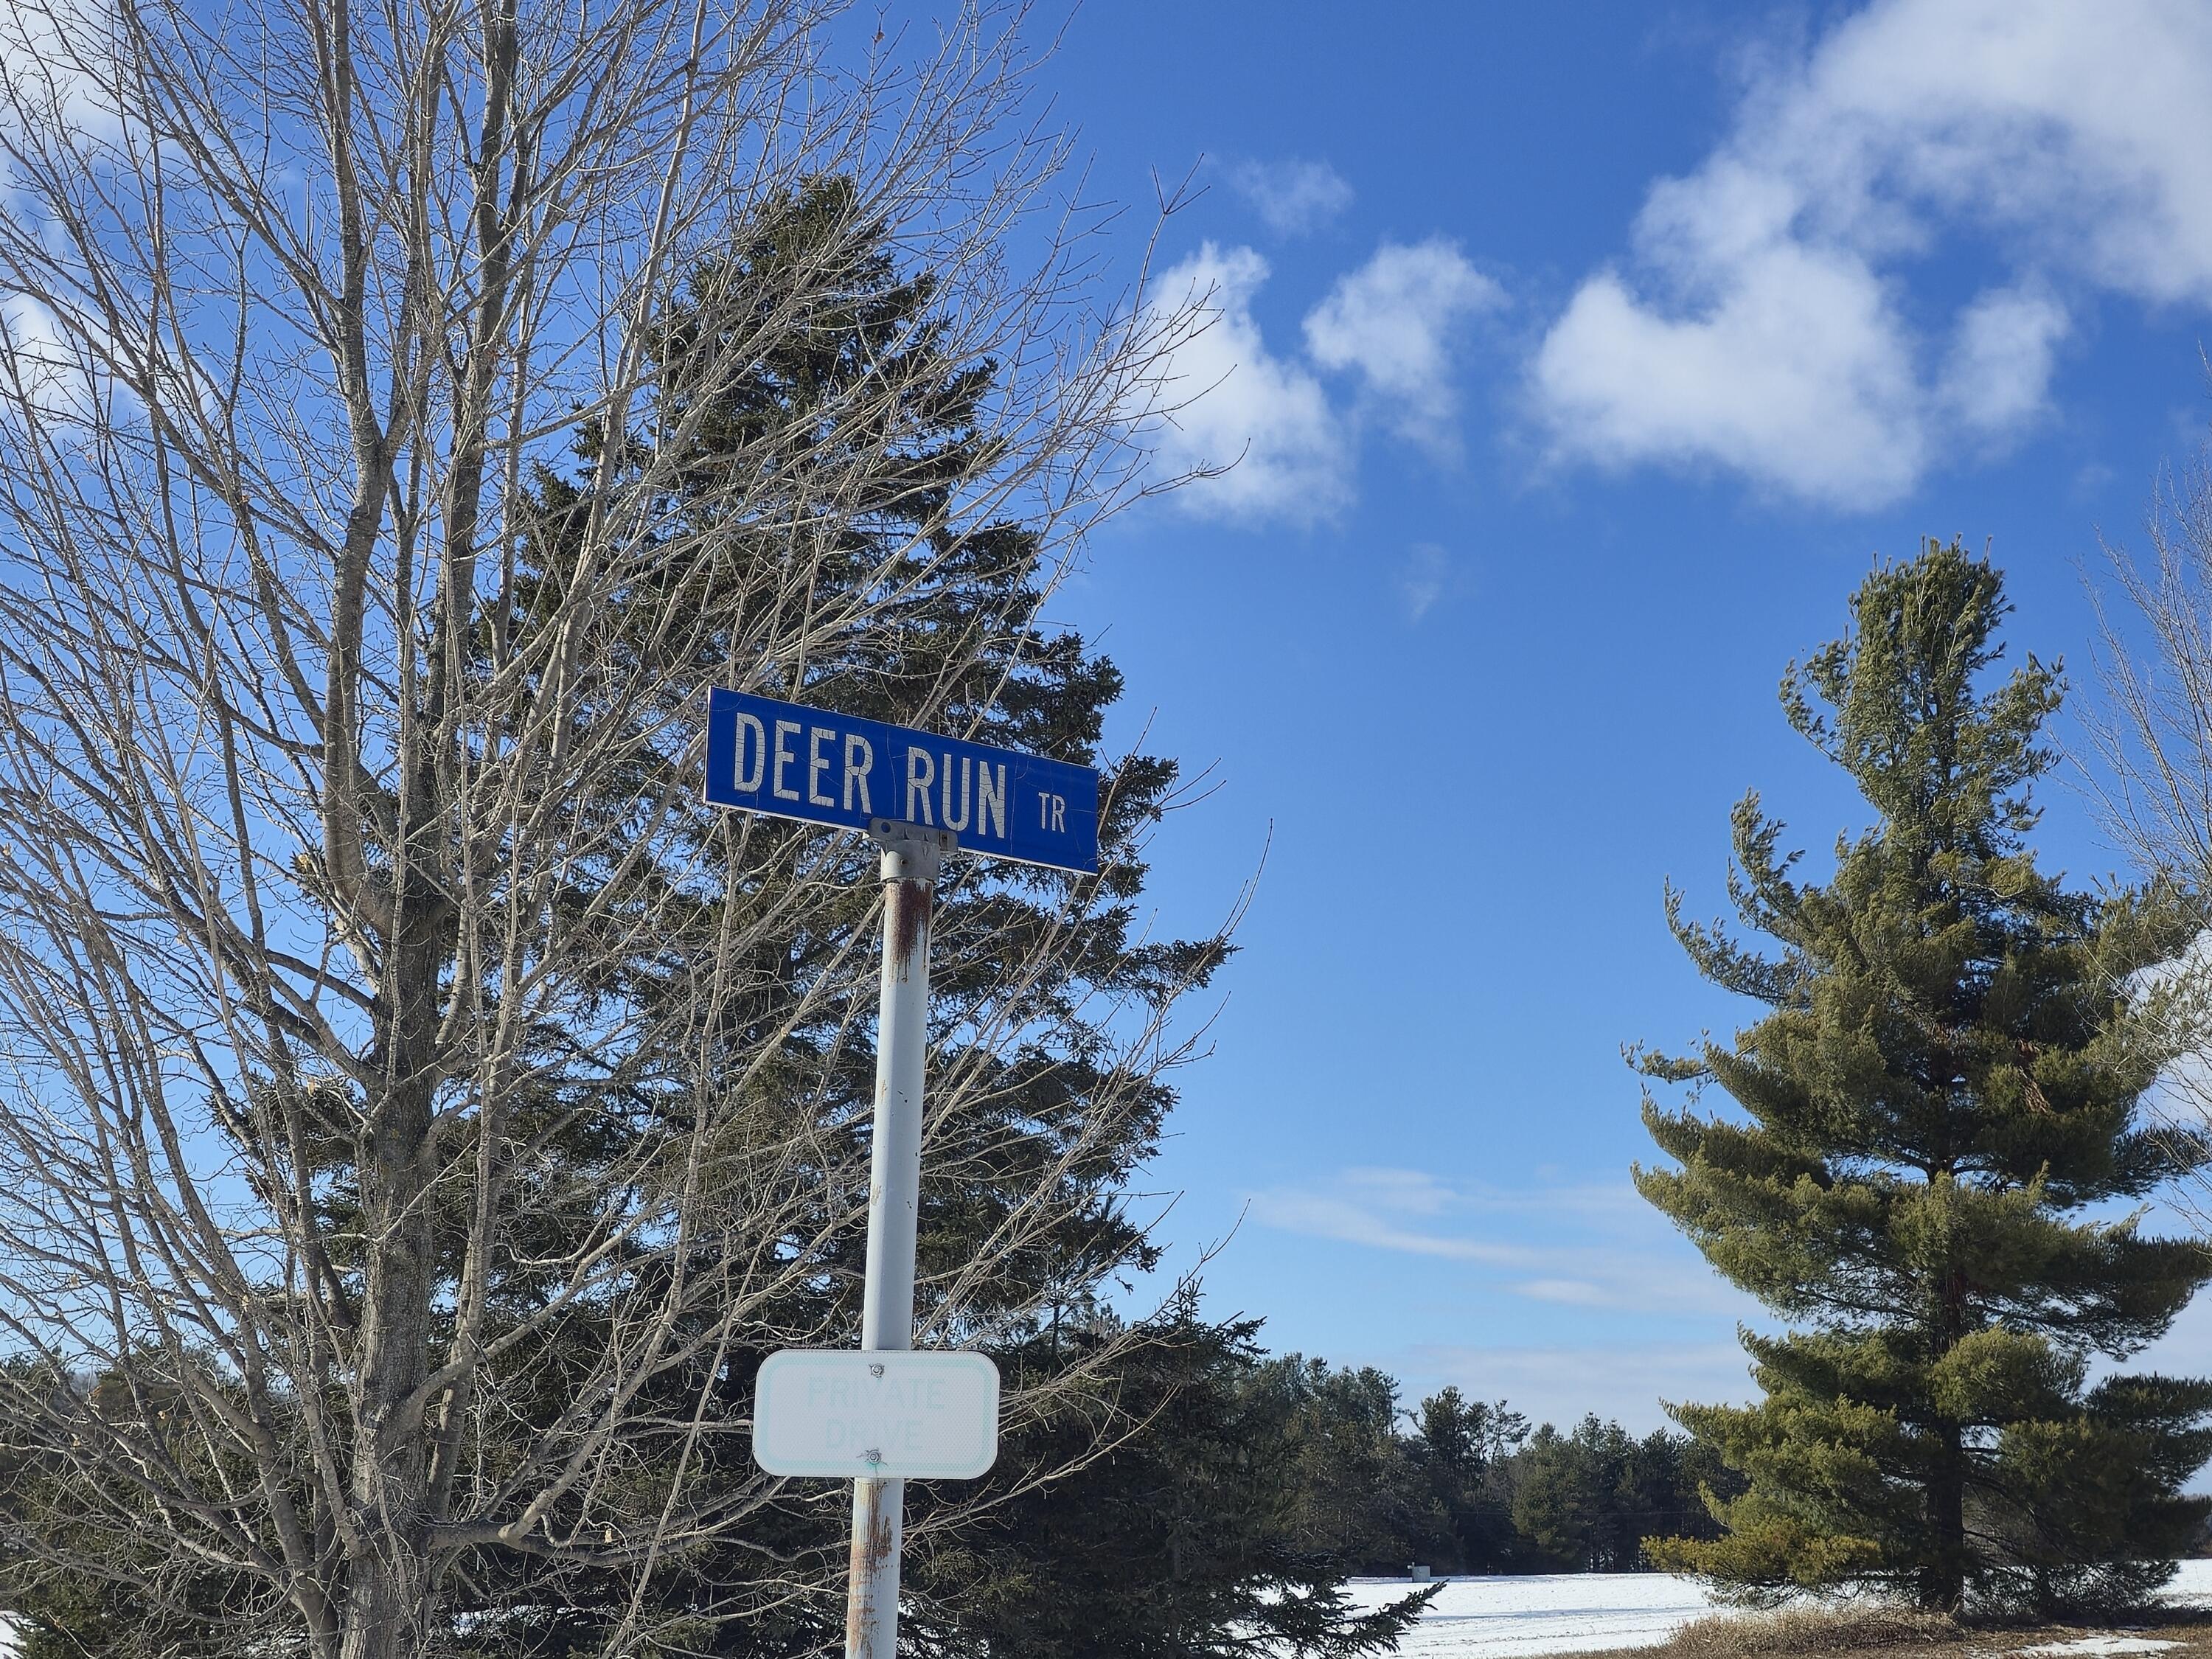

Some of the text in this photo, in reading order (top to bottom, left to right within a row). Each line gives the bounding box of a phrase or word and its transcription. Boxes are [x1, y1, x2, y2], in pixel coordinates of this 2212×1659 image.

[734, 712, 1065, 838] DEER RUN TR
[808, 1377, 945, 1409] PRIVATE
[826, 1419, 923, 1450] DRIVE
